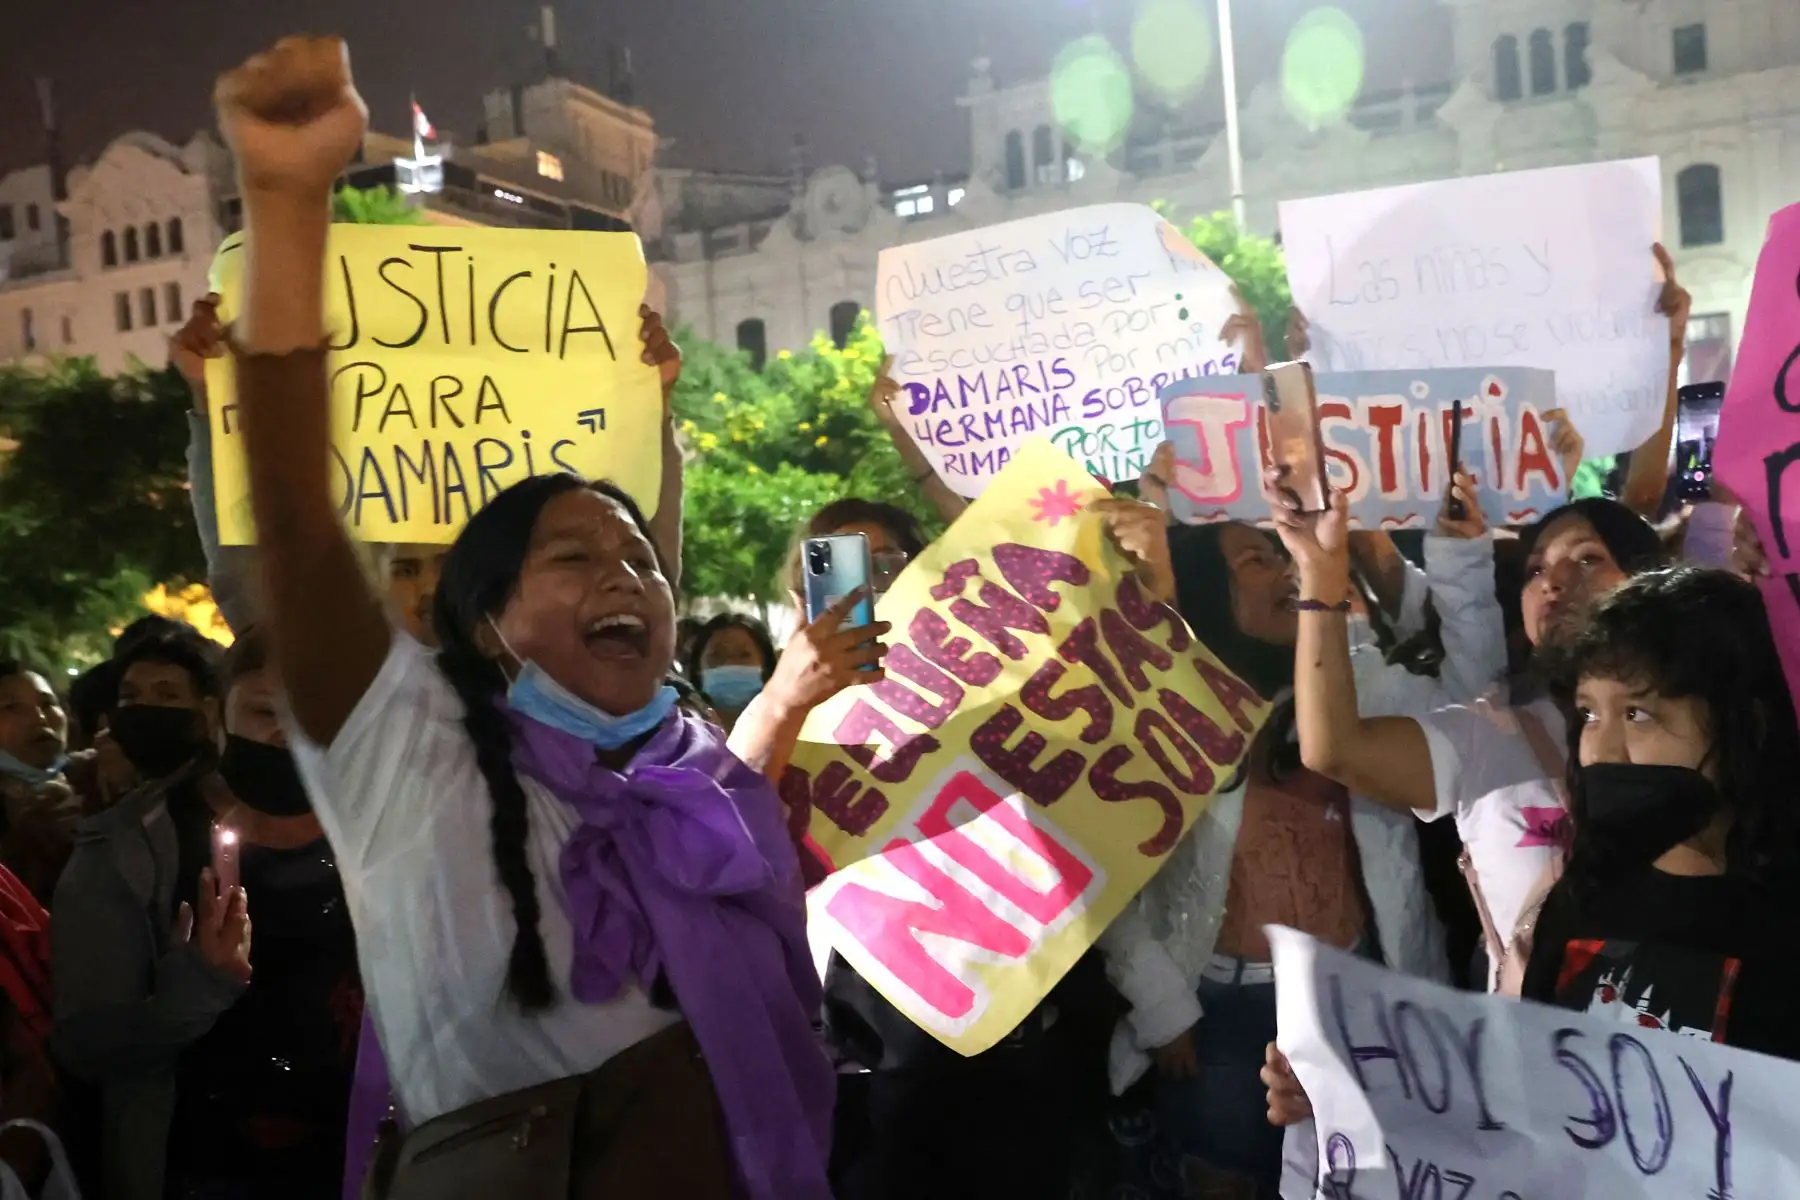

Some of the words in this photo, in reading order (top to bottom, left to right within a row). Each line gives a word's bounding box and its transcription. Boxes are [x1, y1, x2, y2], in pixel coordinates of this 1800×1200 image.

[886, 239, 1037, 306] Nuestra
[1004, 287, 1068, 338] que
[1079, 270, 1153, 310] ser
[1326, 234, 1399, 305] Las
[332, 362, 512, 433] PARA
[903, 358, 1076, 415] DAMARIS
[1050, 425, 1119, 458] POR
[970, 570, 1190, 808] ESTAS
[1088, 658, 1264, 858] SOLA
[825, 769, 1094, 1018] NO
[1328, 974, 1506, 1131] HOY
[1551, 1027, 1735, 1200] SOY
